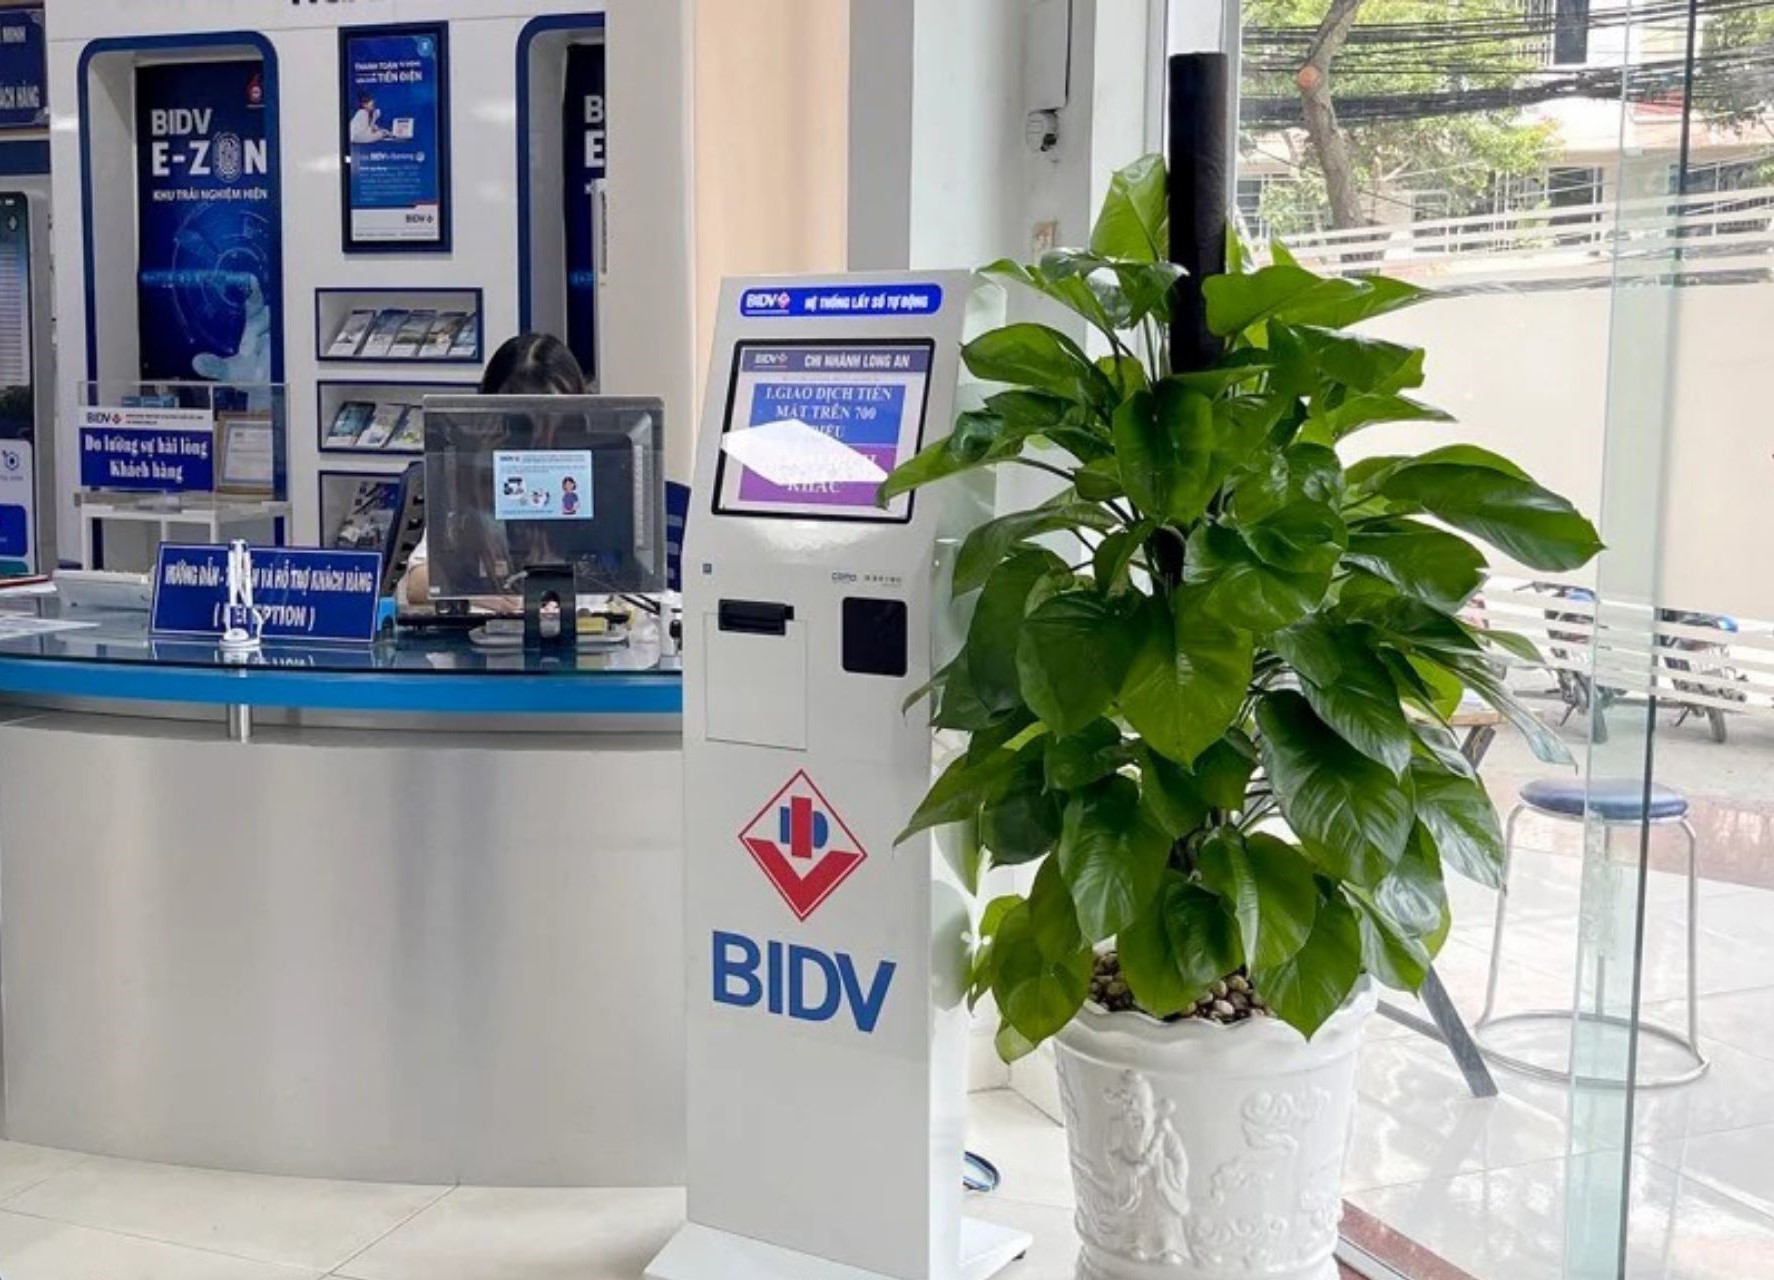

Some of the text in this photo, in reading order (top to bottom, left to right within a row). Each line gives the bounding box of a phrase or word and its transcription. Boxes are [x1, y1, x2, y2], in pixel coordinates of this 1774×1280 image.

[151, 108, 213, 136] BIDV
[153, 189, 176, 201] KHU
[746, 293, 778, 308] BIDV
[819, 292, 850, 310] THỐNG
[851, 291, 870, 309] LẤY
[871, 290, 887, 309] SỐ
[804, 353, 823, 368] CHI
[823, 350, 862, 369] NHÁNH
[862, 353, 892, 369] LONG
[893, 353, 911, 368] AN
[815, 386, 854, 403] DỊCH
[856, 383, 894, 401] TIỀN
[87, 411, 112, 424] BIDV
[808, 402, 851, 420] TRÊN
[109, 459, 184, 484] Khách hàng
[310, 564, 345, 592] KHÁCH
[345, 565, 374, 594] HÀNG
[223, 603, 308, 628] EEPTION
[712, 930, 898, 1035] BIDV
